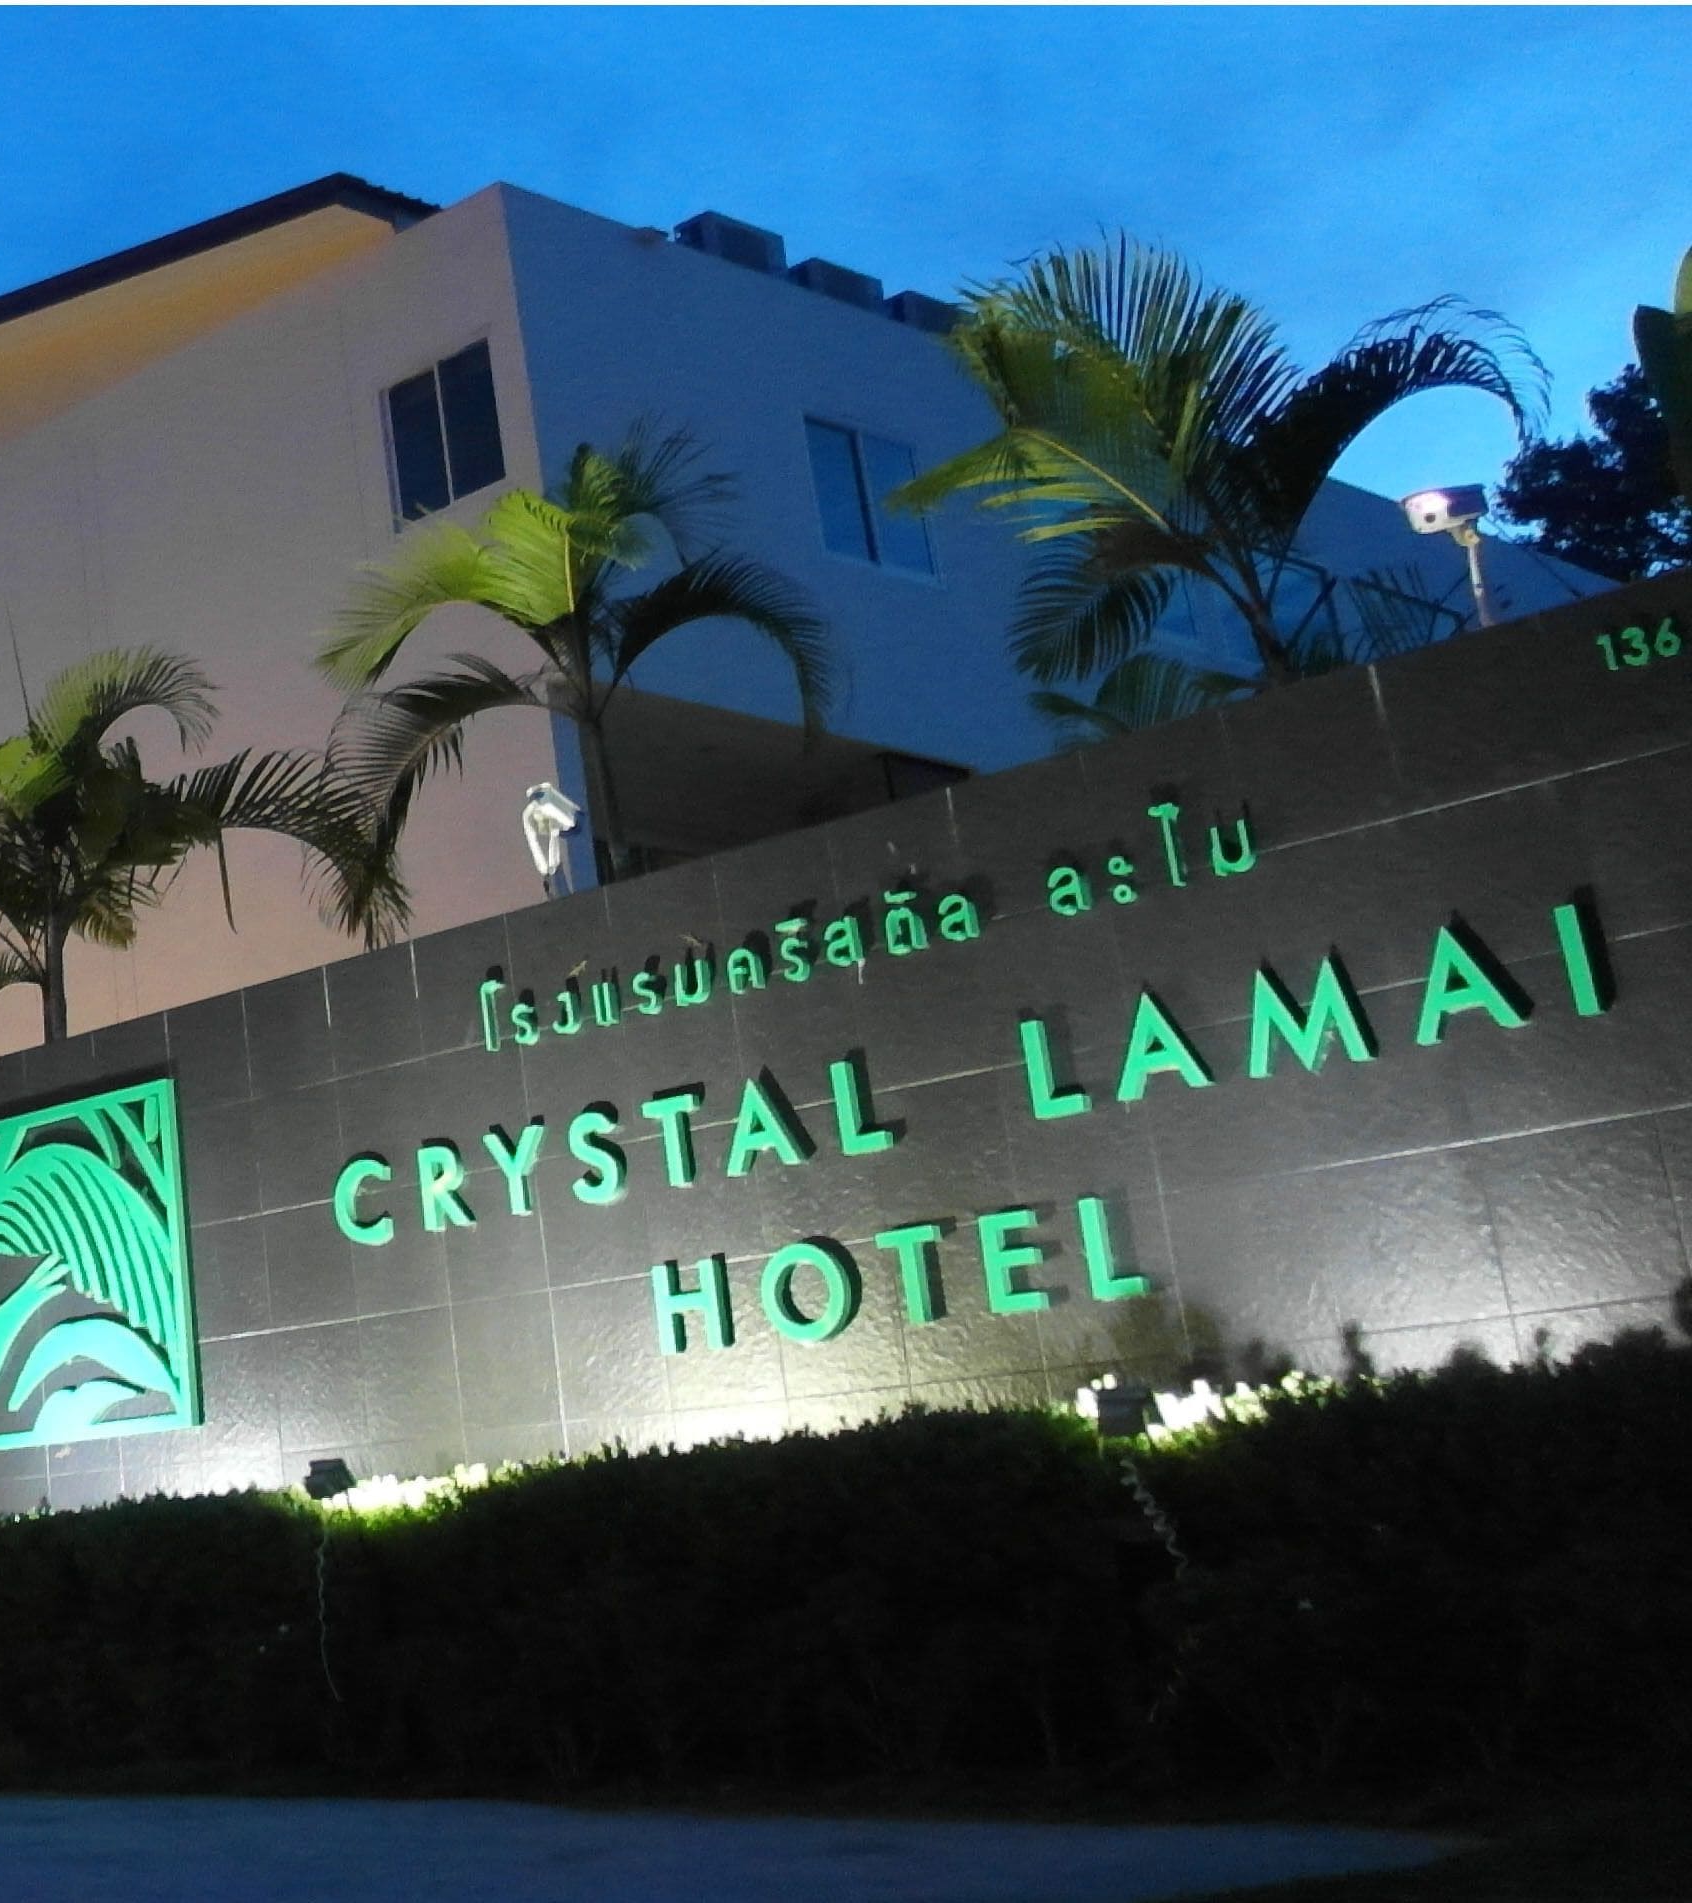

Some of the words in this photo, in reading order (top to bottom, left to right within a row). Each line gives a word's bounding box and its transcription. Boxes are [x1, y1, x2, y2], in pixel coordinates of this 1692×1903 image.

[1596, 617, 1682, 671] 136
[332, 1060, 895, 1247] CRYSTAL
[1017, 904, 1606, 1121] LAMAI
[650, 1195, 1151, 1355] HOTEL
